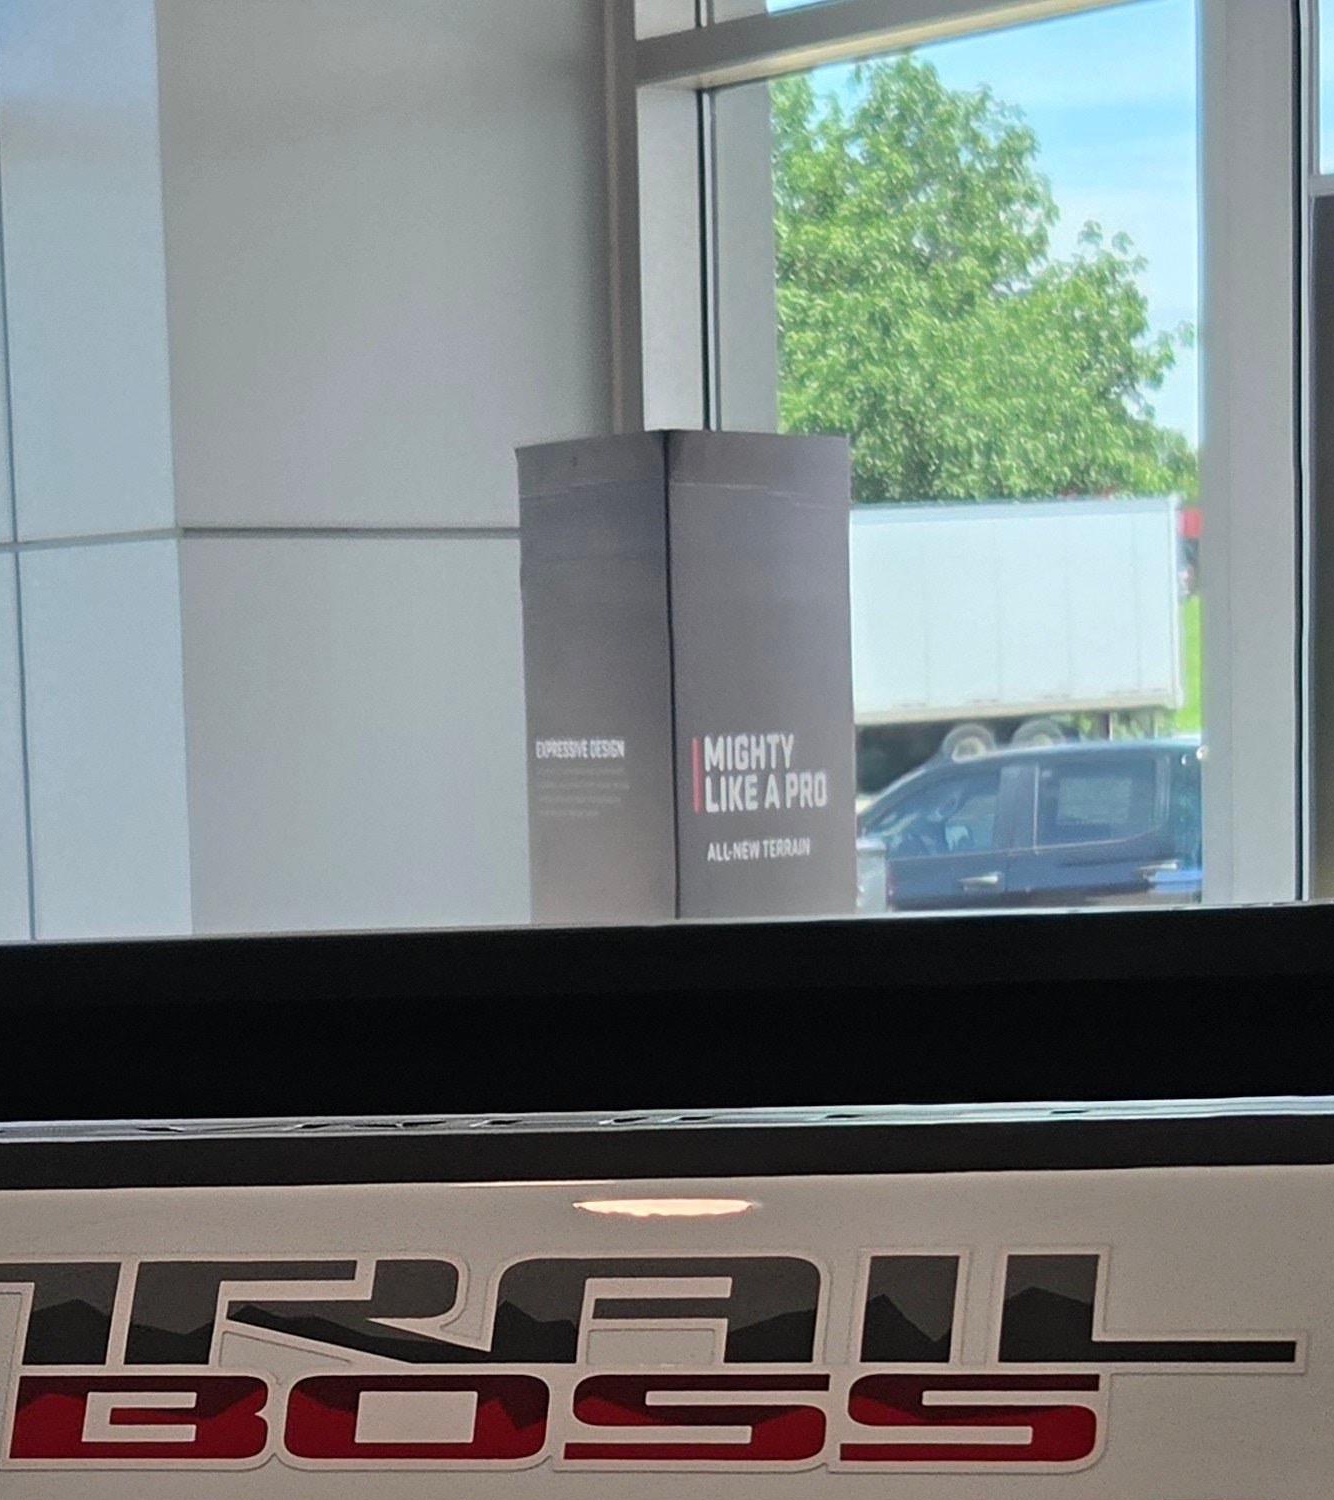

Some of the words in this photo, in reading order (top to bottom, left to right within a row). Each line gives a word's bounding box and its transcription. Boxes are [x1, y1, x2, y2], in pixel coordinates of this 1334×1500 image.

[703, 734, 794, 772] MIGHTY
[705, 774, 758, 813] LIKE
[765, 775, 780, 809] A
[785, 772, 828, 808] PRO
[707, 841, 760, 861] ALL-NEW
[763, 838, 811, 857] TERRAIN
[9, 1373, 1101, 1462] BOSS
